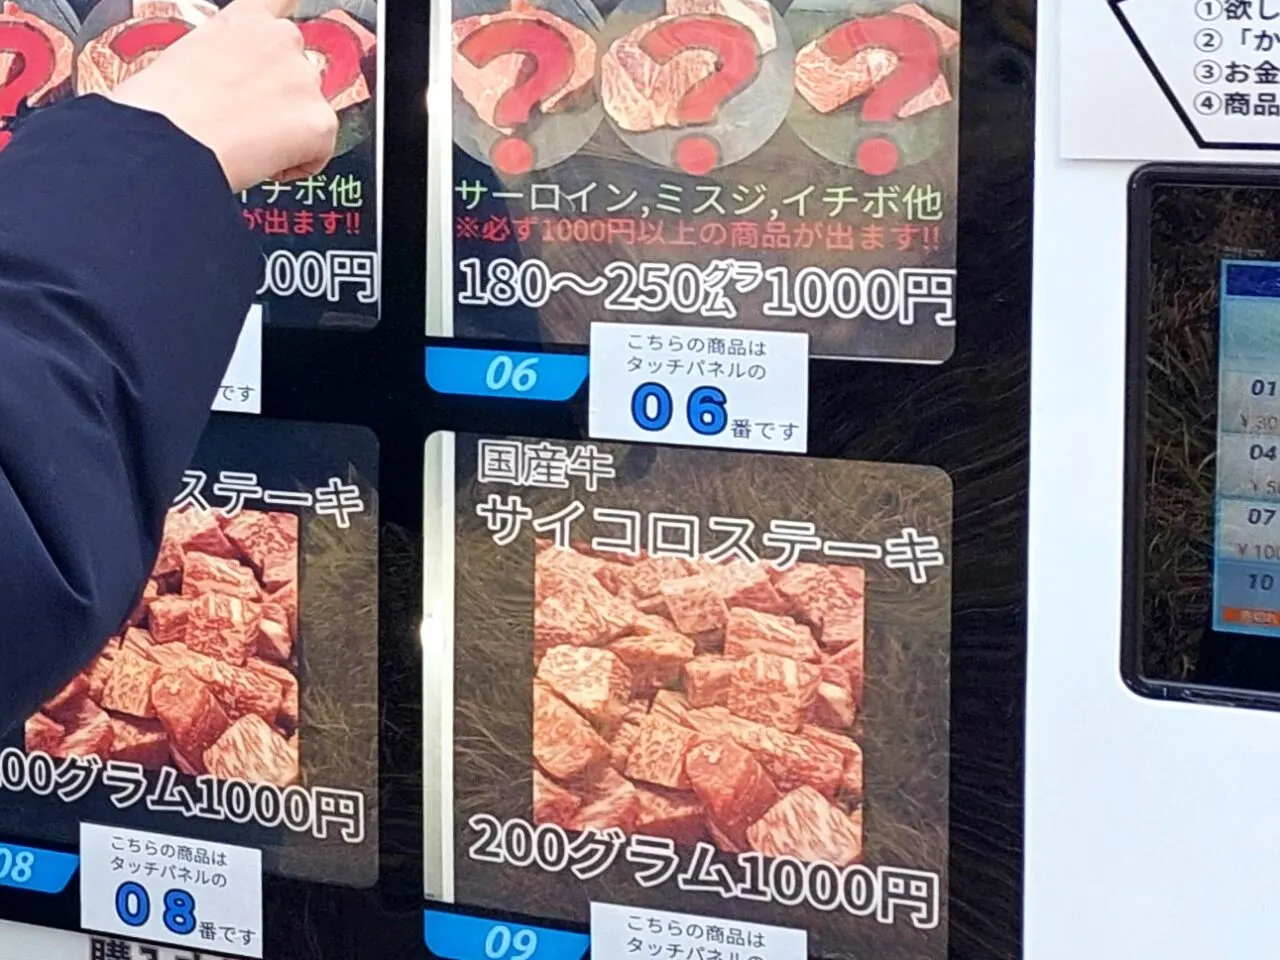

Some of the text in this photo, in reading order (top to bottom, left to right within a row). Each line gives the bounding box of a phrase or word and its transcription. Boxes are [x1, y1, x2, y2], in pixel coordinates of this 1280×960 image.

[255, 249, 379, 303] 00円
[627, 334, 766, 357] こちらの商品は
[486, 355, 538, 390] 06
[627, 357, 766, 380] タッチパネルの
[1251, 380, 1276, 396] 01
[478, 440, 615, 491] 国産牛
[1249, 444, 1276, 461] 04
[1248, 508, 1276, 525] 07
[477, 494, 944, 583] サイコロステーキ
[1249, 574, 1274, 590] 10
[111, 835, 227, 866] こちらの商品は
[110, 856, 227, 888] タッチパネルの
[469, 814, 940, 928] 200グラム1000円
[486, 926, 537, 959] 09
[627, 915, 766, 947] こちらの商品は
